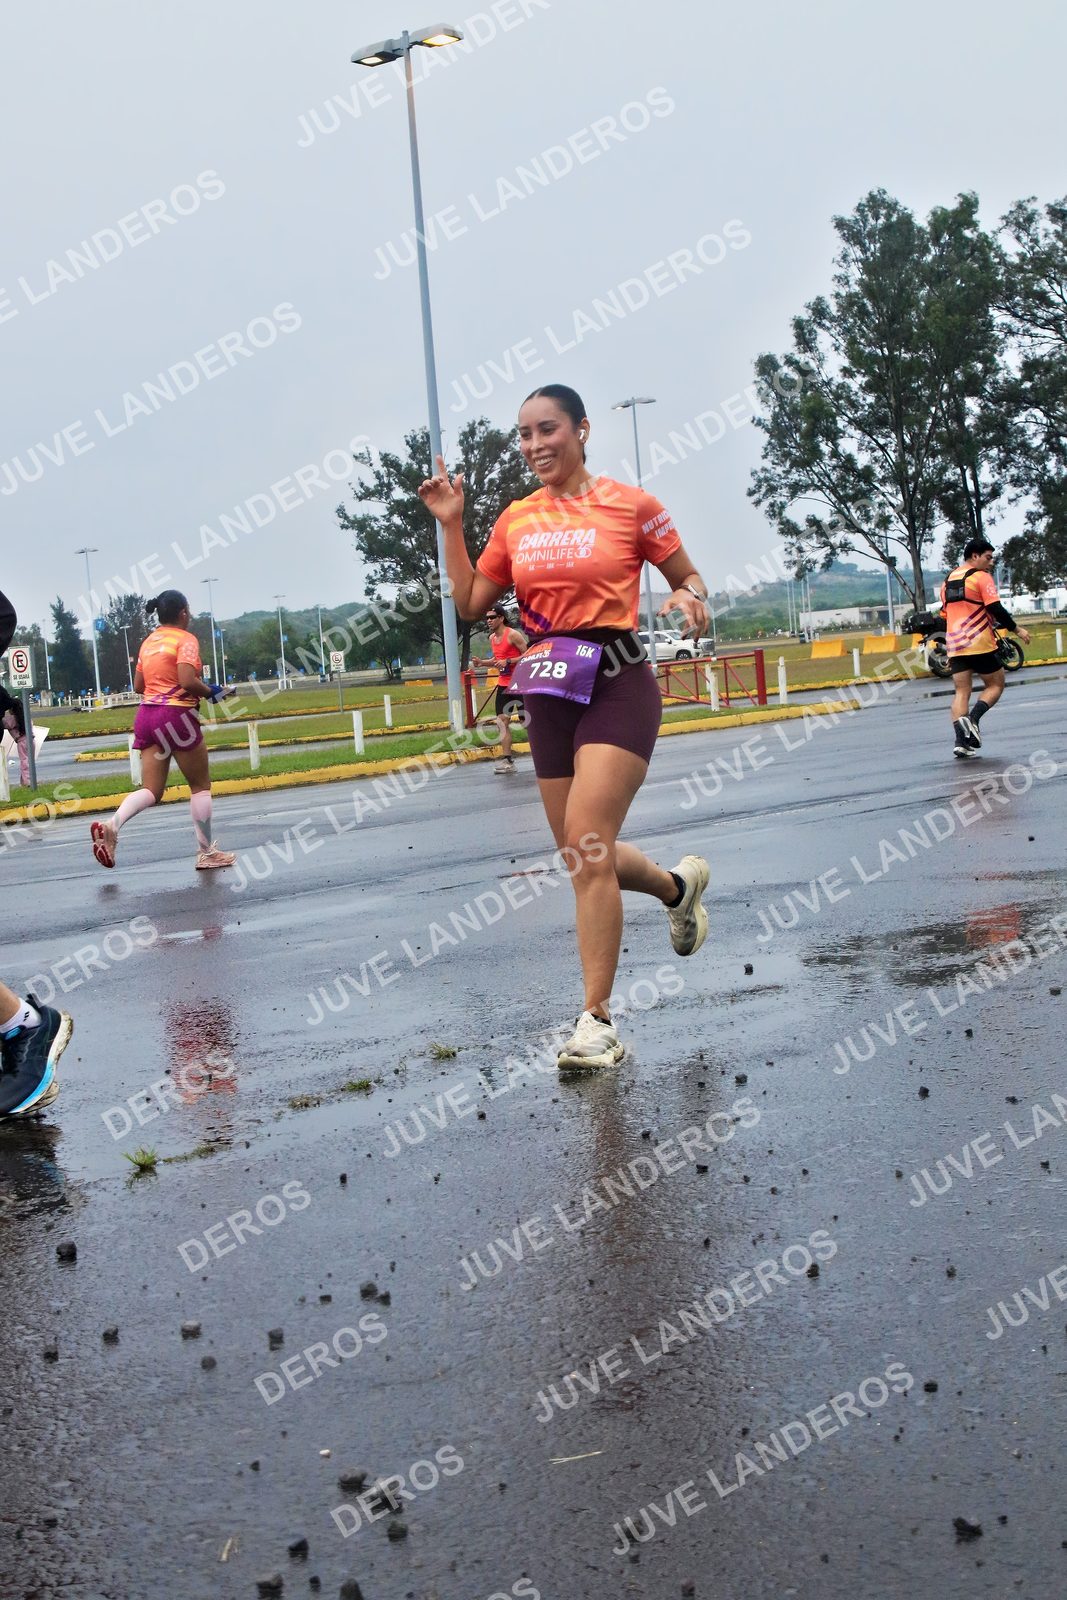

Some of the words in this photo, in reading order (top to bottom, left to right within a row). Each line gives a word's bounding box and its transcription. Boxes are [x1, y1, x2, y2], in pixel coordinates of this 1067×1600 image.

[518, 528, 597, 551] CARRERA
[516, 548, 574, 564] OMNILIFE
[529, 661, 568, 679] 728
